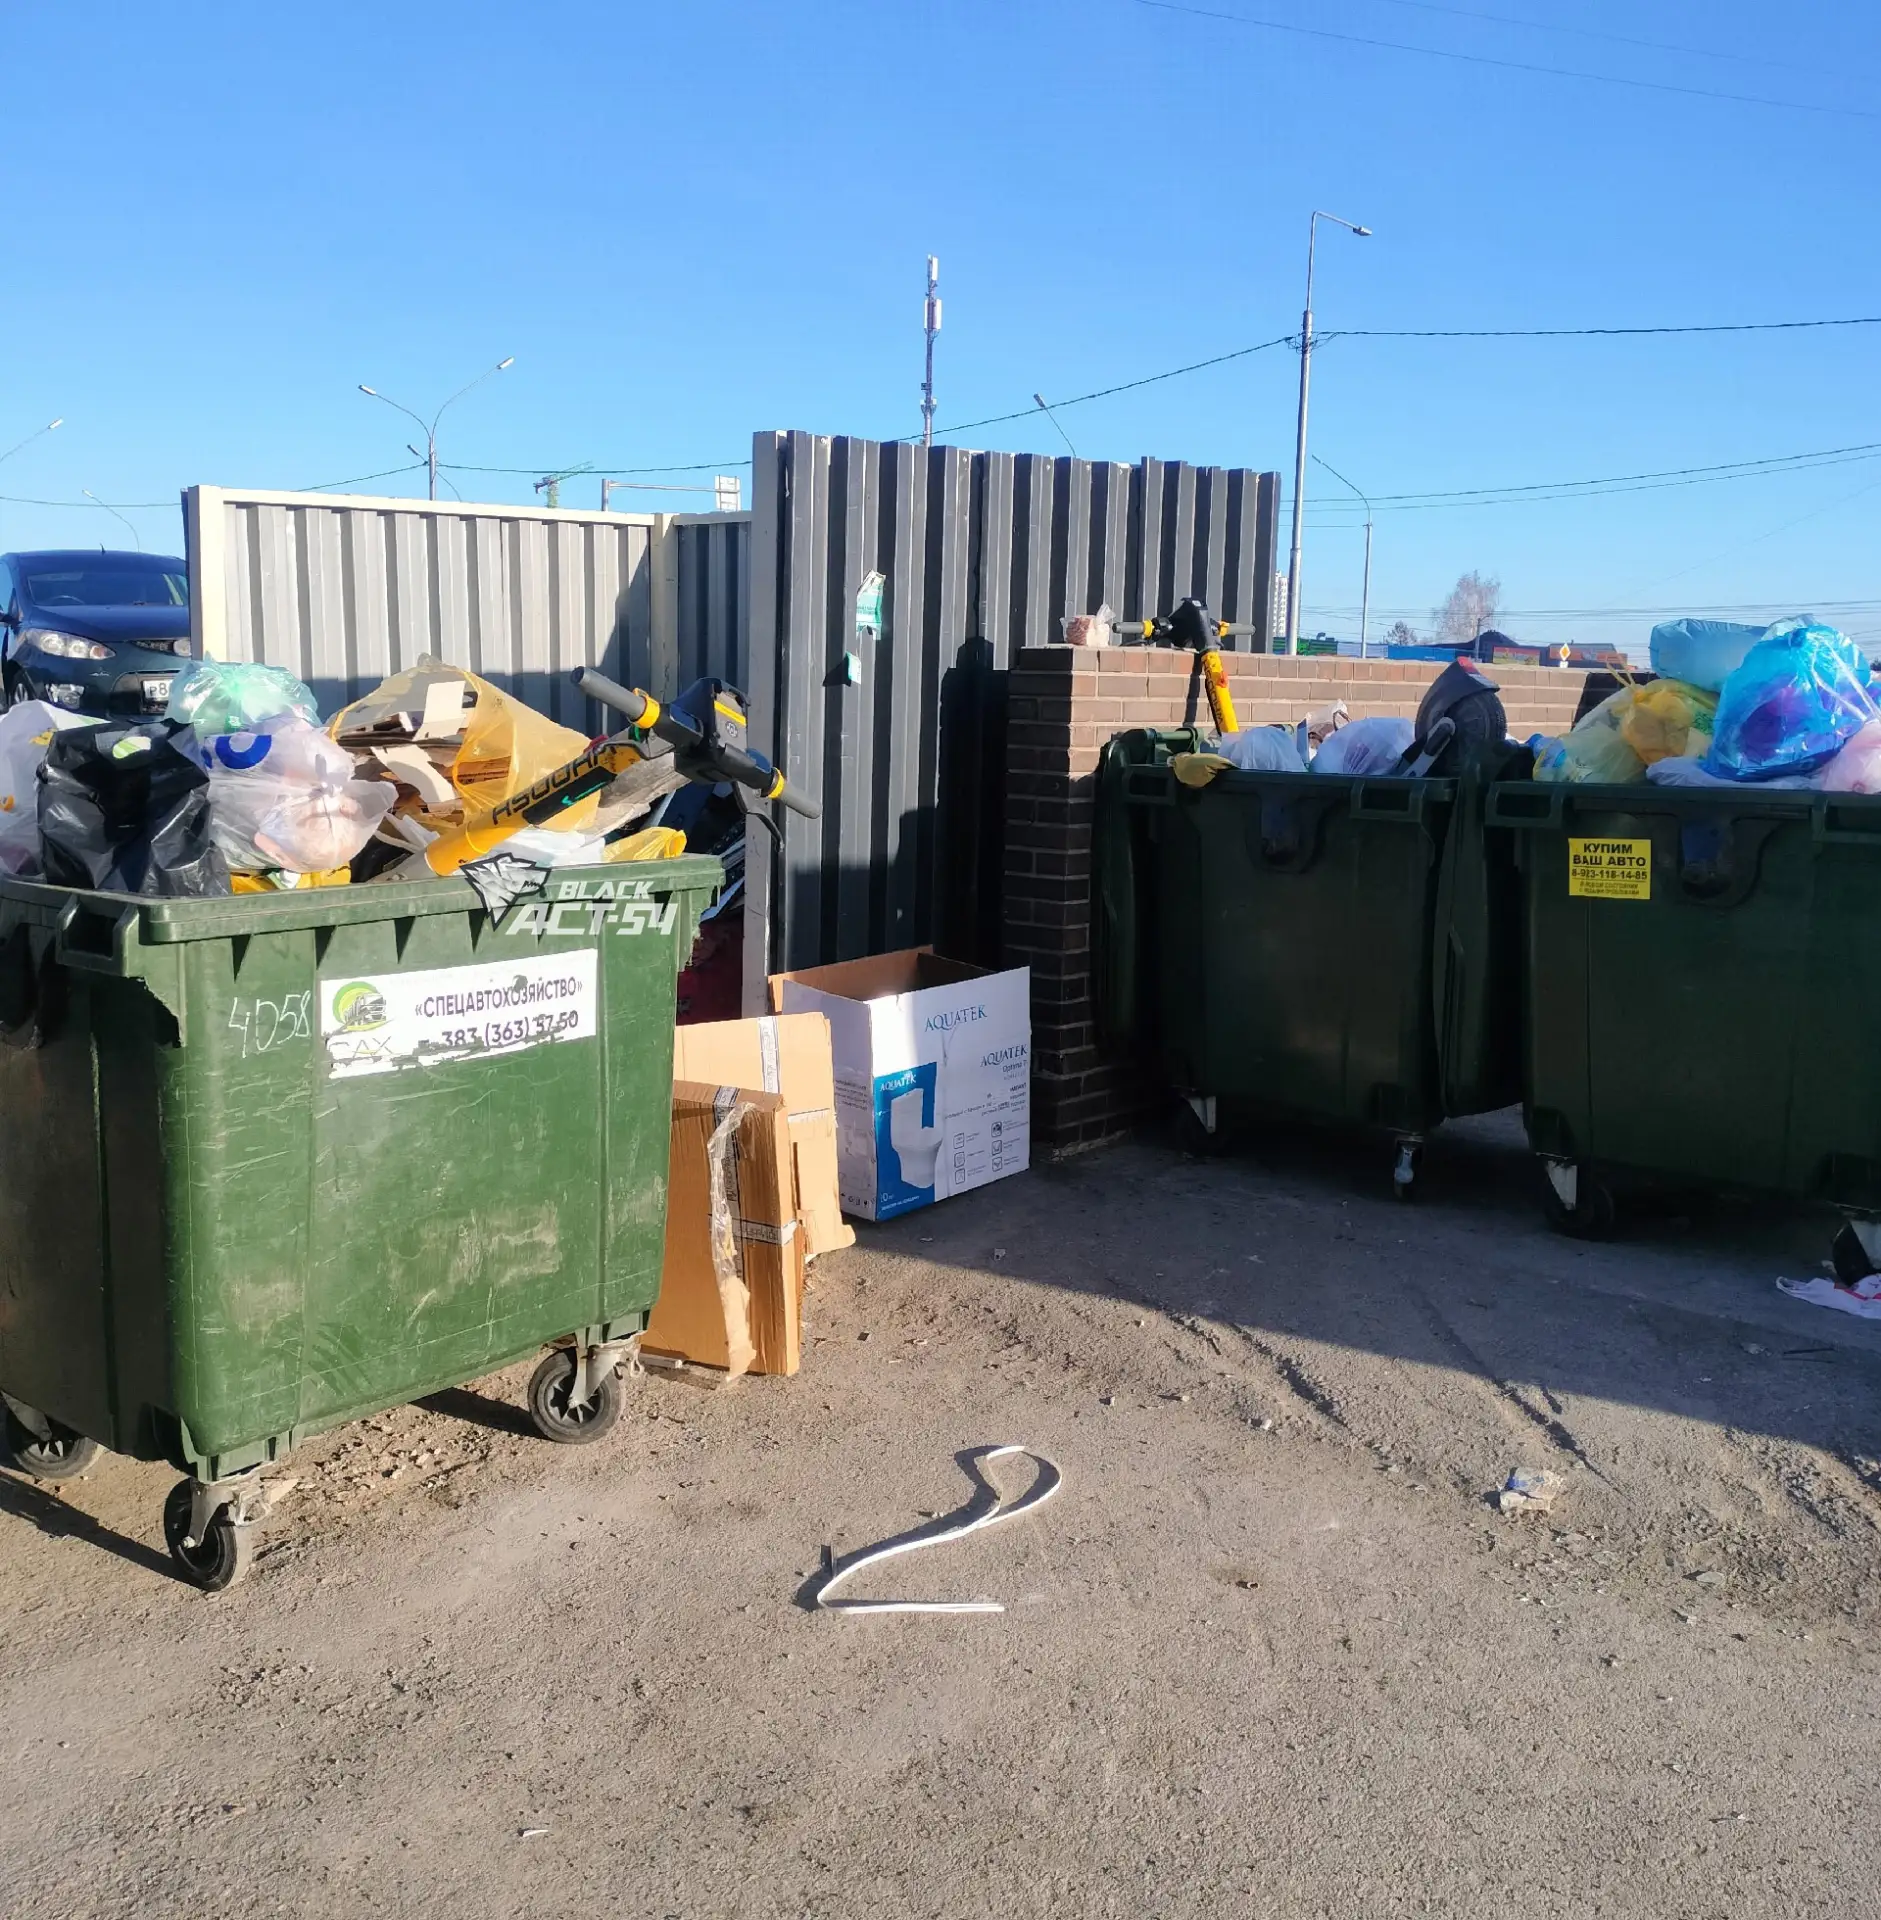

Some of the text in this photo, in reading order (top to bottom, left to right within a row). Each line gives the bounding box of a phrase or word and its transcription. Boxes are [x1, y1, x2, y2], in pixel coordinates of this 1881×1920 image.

[1583, 843, 1632, 854] КУПИМ
[1573, 855, 1646, 867] ВАШ АВТО
[925, 1004, 988, 1033] AQUATEK
[485, 1017, 529, 1046] (363)
[980, 1044, 1028, 1068] AQUATEK
[880, 1070, 917, 1091] AQUATEK
